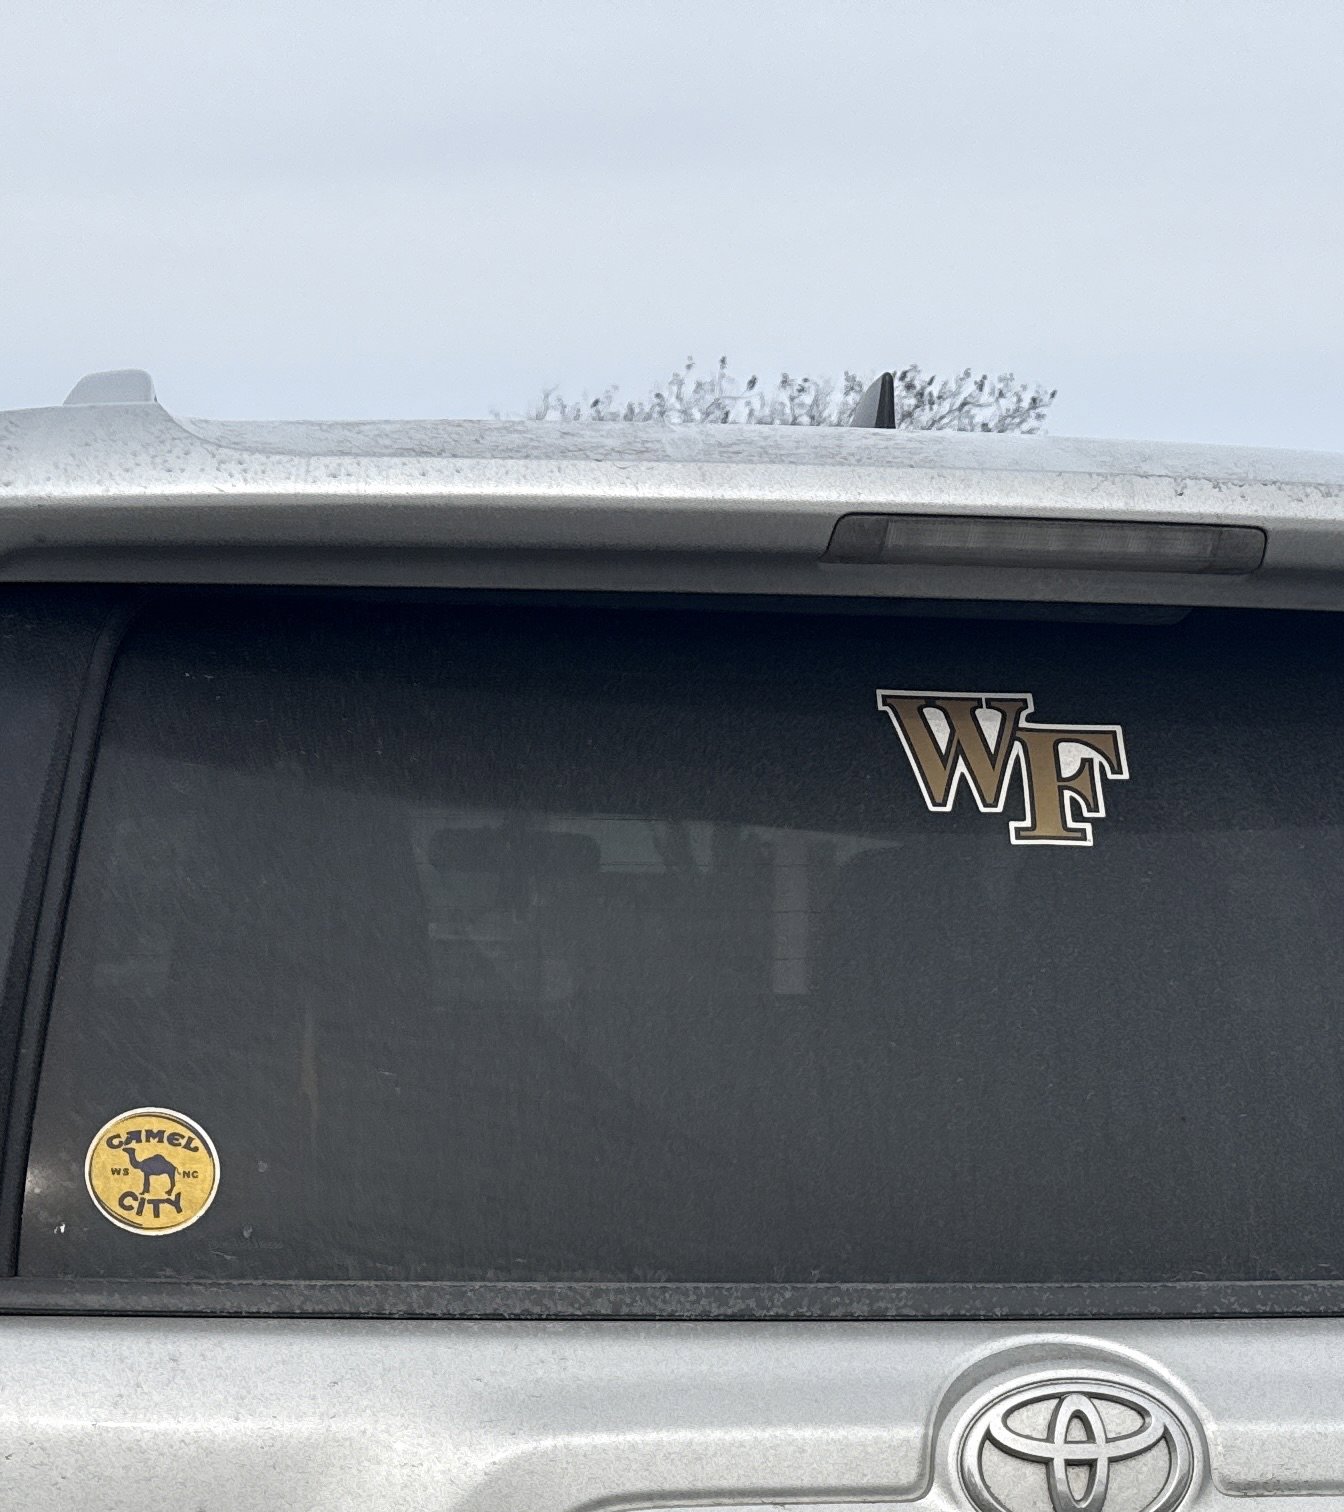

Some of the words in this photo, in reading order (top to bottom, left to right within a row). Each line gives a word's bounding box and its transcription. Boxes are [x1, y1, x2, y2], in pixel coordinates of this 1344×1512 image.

[876, 689, 1130, 846] WF
[106, 1129, 199, 1152] CAMEL
[111, 1167, 130, 1176] WS
[118, 1190, 183, 1218] CITY
